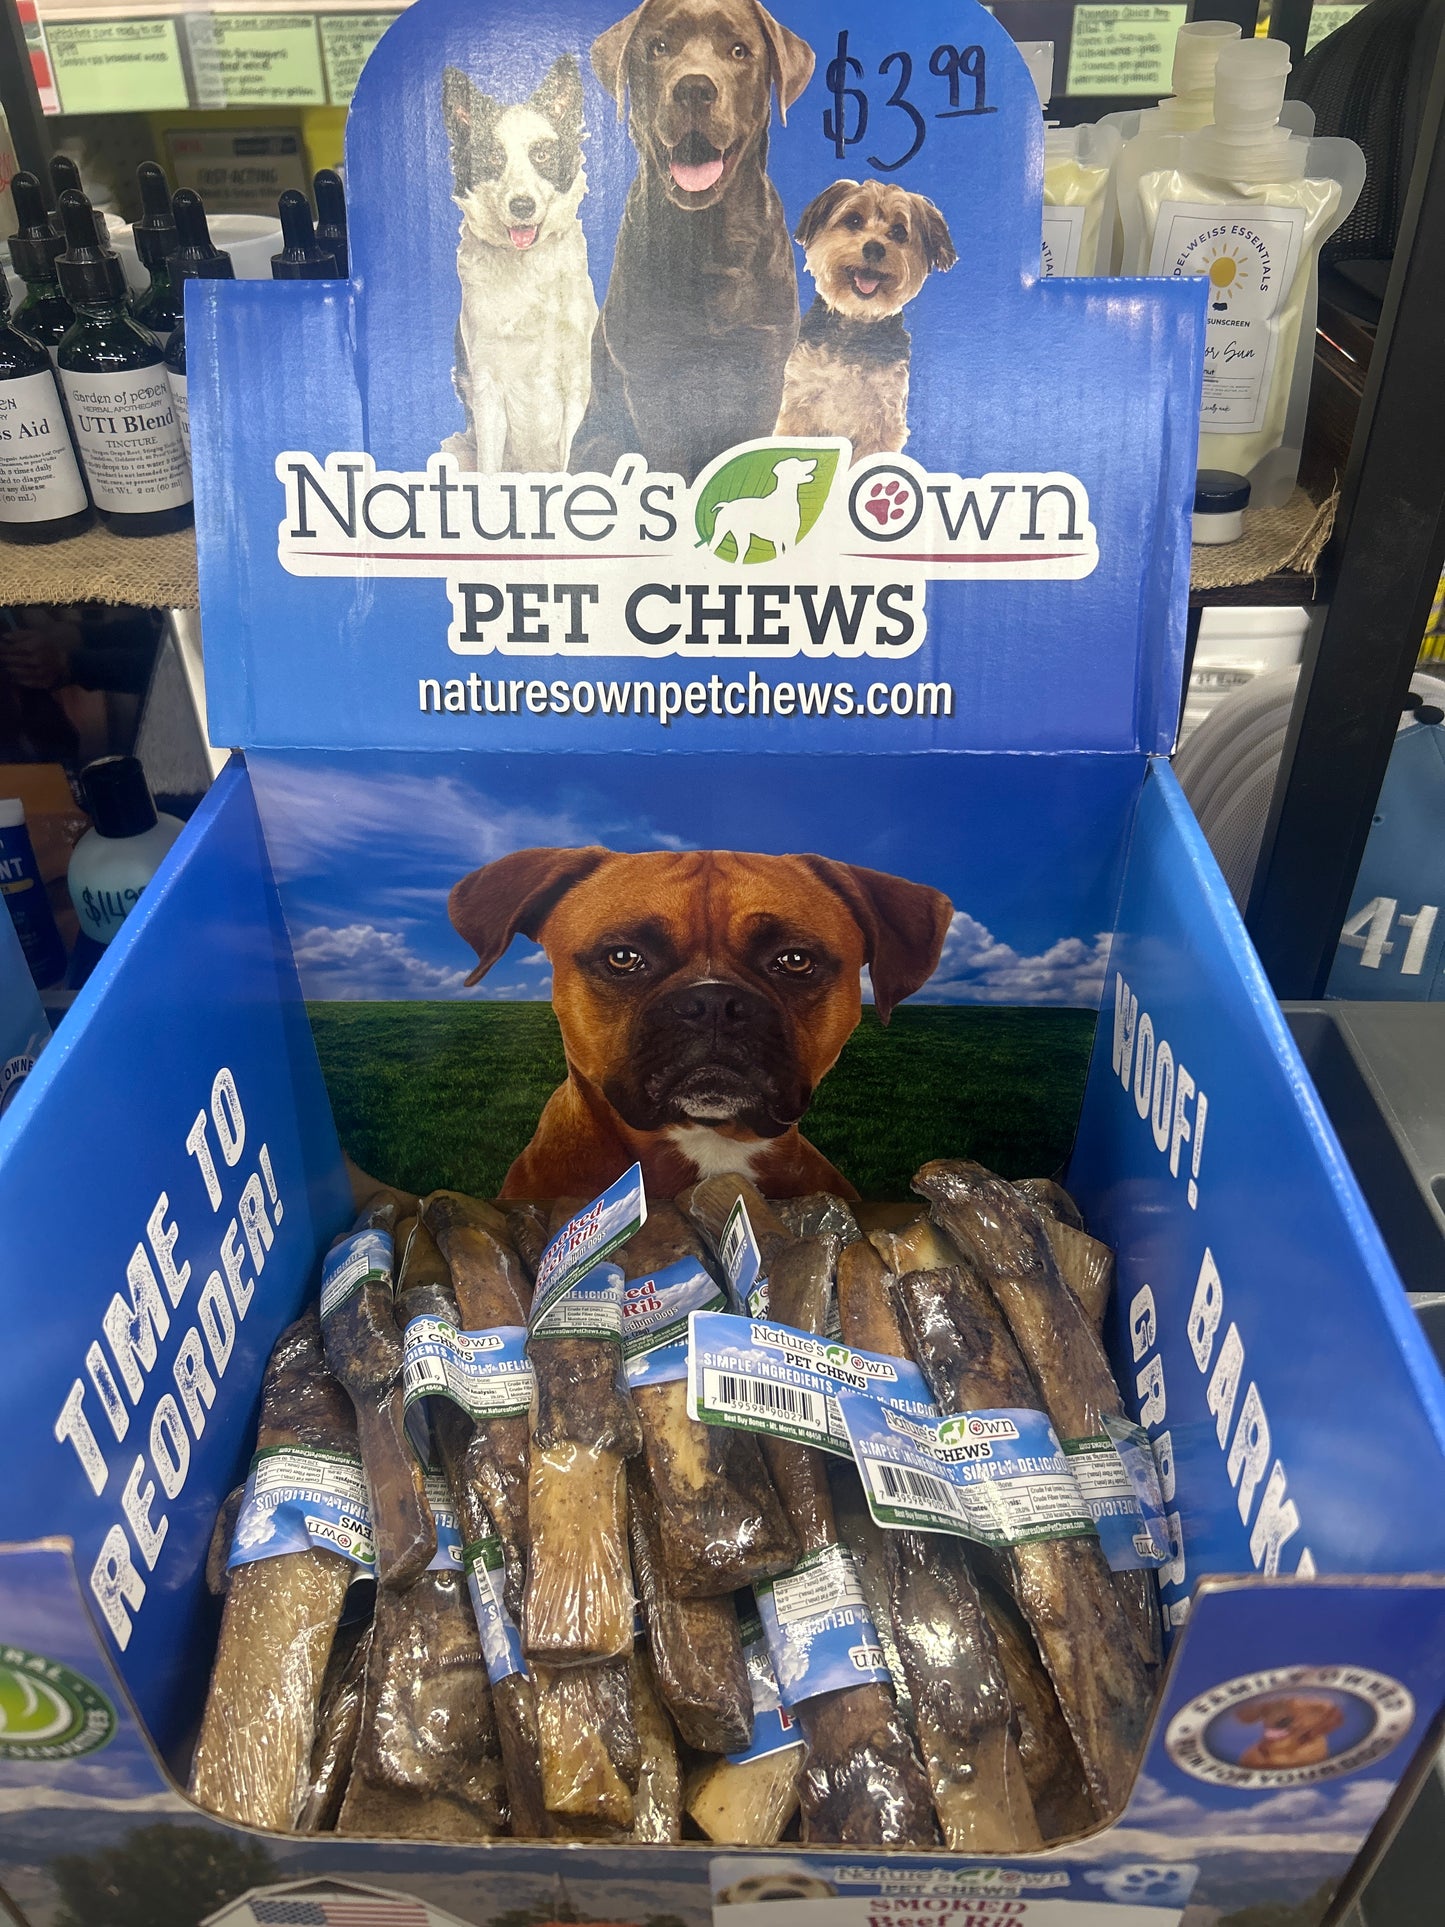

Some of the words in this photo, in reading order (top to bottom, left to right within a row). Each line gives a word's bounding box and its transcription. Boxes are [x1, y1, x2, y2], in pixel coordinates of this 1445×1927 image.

[1231, 225, 1271, 292] ESSENTIALS
[1207, 318, 1251, 328] SUNSCREEN
[1223, 340, 1255, 363] Sun
[73, 390, 111, 404] Garden
[114, 391, 127, 405] of
[83, 405, 113, 413] HERBAL
[114, 400, 162, 413] APOTHECARY
[19, 419, 50, 439] Aid
[78, 414, 118, 434] UTI
[122, 407, 174, 434] Blend
[105, 437, 159, 449] TINCTURE
[35, 464, 52, 472] daily
[102, 463, 119, 472] drops
[147, 461, 164, 469] water
[136, 468, 162, 477] intended
[20, 484, 45, 492] disease
[102, 485, 114, 494] Net
[116, 486, 133, 494] Wt.
[134, 478, 157, 487] prevent
[287, 463, 678, 541] Nature's
[848, 464, 1084, 542] Own
[458, 583, 599, 643] PET
[624, 583, 916, 647] CHEWS
[418, 671, 954, 726] naturesownpetchews.com
[1340, 896, 1439, 976] 41
[1112, 971, 1209, 1211] WOOF!
[569, 1221, 600, 1253] Rib
[588, 1231, 607, 1249] Dogs
[54, 1190, 192, 1497] TIME
[186, 1067, 247, 1213] TO
[624, 1281, 656, 1300] ed
[623, 1297, 662, 1318] Rib
[654, 1307, 679, 1321] Dogs
[405, 1335, 424, 1351] ET
[428, 1333, 473, 1361] CHEWS
[457, 1336, 501, 1348] Own
[753, 1326, 825, 1358] Nature's
[851, 1355, 895, 1376] Own
[703, 1353, 751, 1373] SIMPLE
[757, 1361, 837, 1394] INGREDIENTS.
[785, 1352, 812, 1370] PET
[816, 1361, 867, 1389] CHEWS
[89, 1142, 285, 1653] REORDER!
[711, 1397, 717, 1405] 7
[731, 1401, 765, 1414] 39598
[770, 1408, 803, 1422] 90027
[815, 1418, 821, 1427] 9
[723, 1413, 736, 1422] Best
[737, 1415, 748, 1426] Buy
[748, 1417, 765, 1428] Bones
[779, 1423, 797, 1436] Morris,
[798, 1428, 805, 1437] MI
[882, 1408, 936, 1442] Nature's
[969, 1419, 1016, 1436] Own
[859, 1440, 900, 1461] SIMPLE
[963, 1461, 1013, 1481] SIMPLY
[934, 1443, 991, 1462] CHEWS
[298, 1464, 321, 1473] Moisture
[333, 1475, 360, 1489] Analysis:
[1031, 1486, 1045, 1494] Crude
[252, 1489, 322, 1512] DELICIOUS.
[880, 1490, 885, 1500] 7
[1047, 1493, 1059, 1501] Fiber
[1036, 1502, 1056, 1511] Moisture
[307, 1521, 352, 1548] Own
[814, 1586, 826, 1594] Fiber
[820, 1592, 829, 1600] Fat
[838, 1867, 950, 1883] Nature's
[1000, 1870, 1067, 1884] Own
[884, 1885, 927, 1895] PET
[932, 1885, 1019, 1897] CHEWS
[869, 1899, 1029, 1914] SMOKED
[866, 1914, 953, 1927] Beef
[963, 1915, 1024, 1927] Rib
